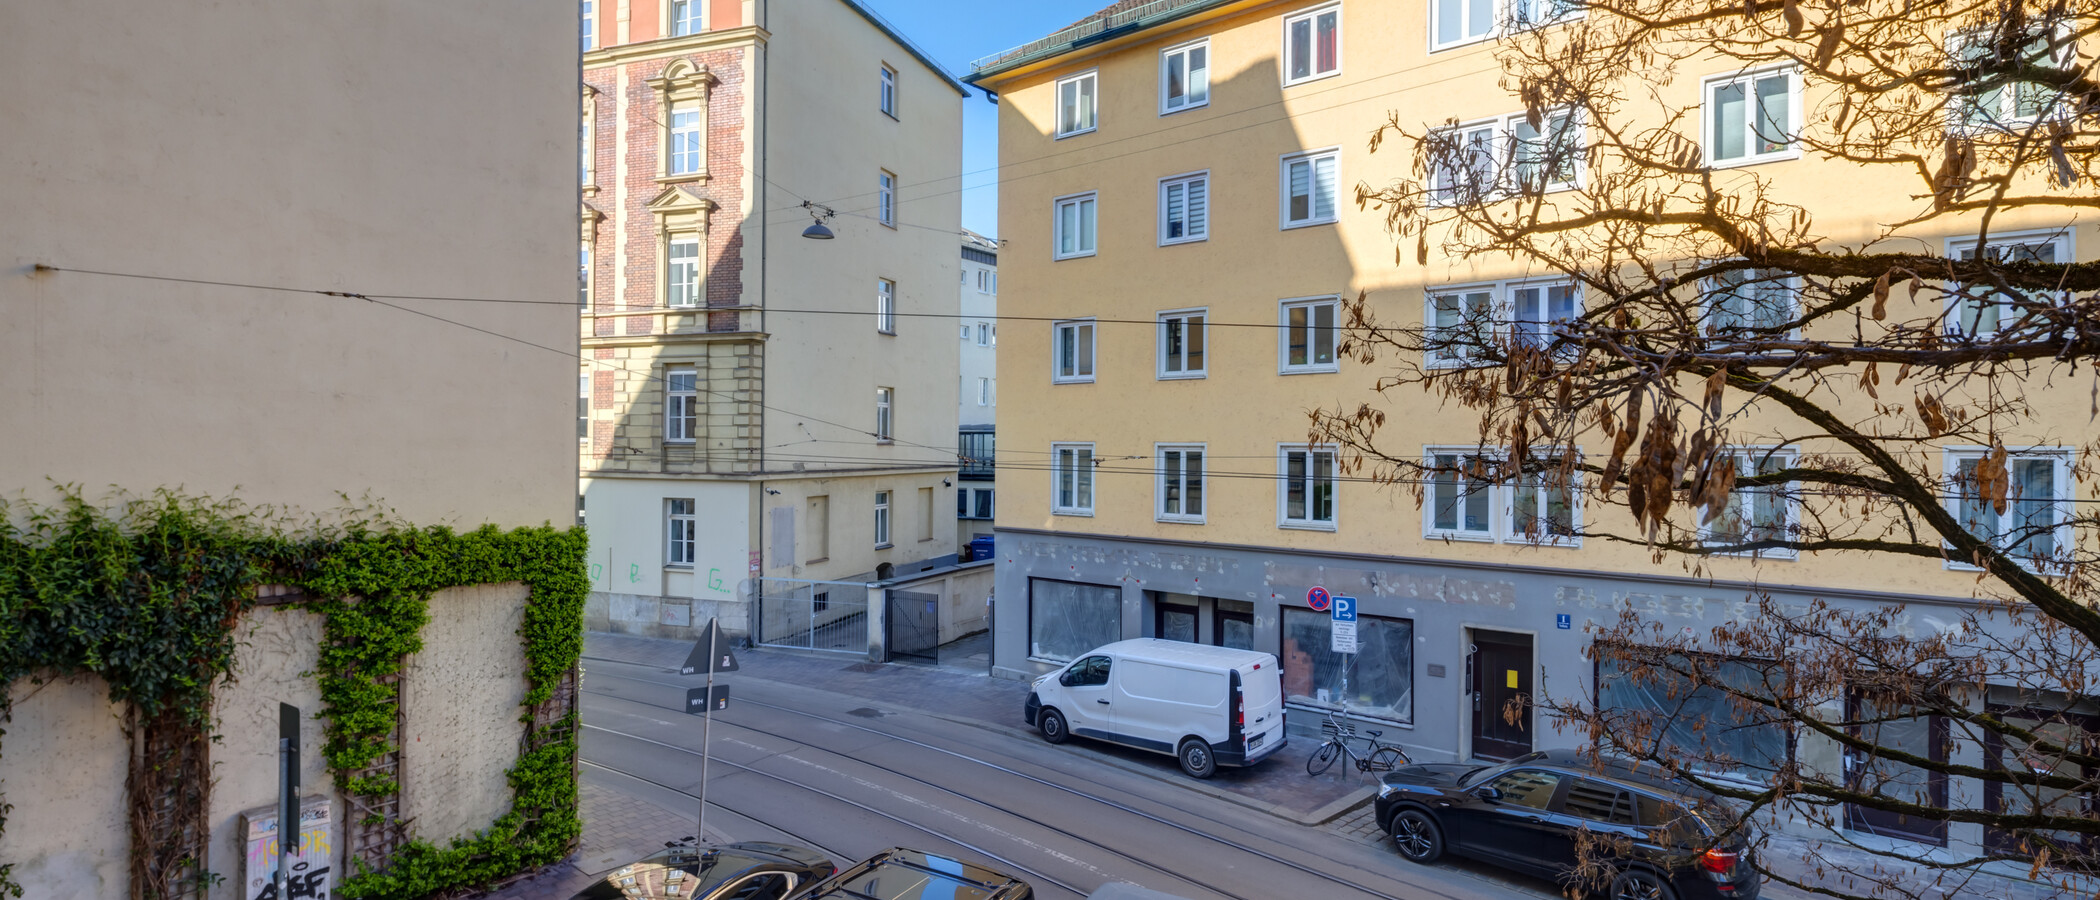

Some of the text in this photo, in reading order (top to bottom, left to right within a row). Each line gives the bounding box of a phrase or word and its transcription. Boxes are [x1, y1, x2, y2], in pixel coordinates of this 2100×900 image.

[1335, 599, 1350, 618] P
[682, 666, 695, 675] WH
[691, 698, 704, 706] WH
